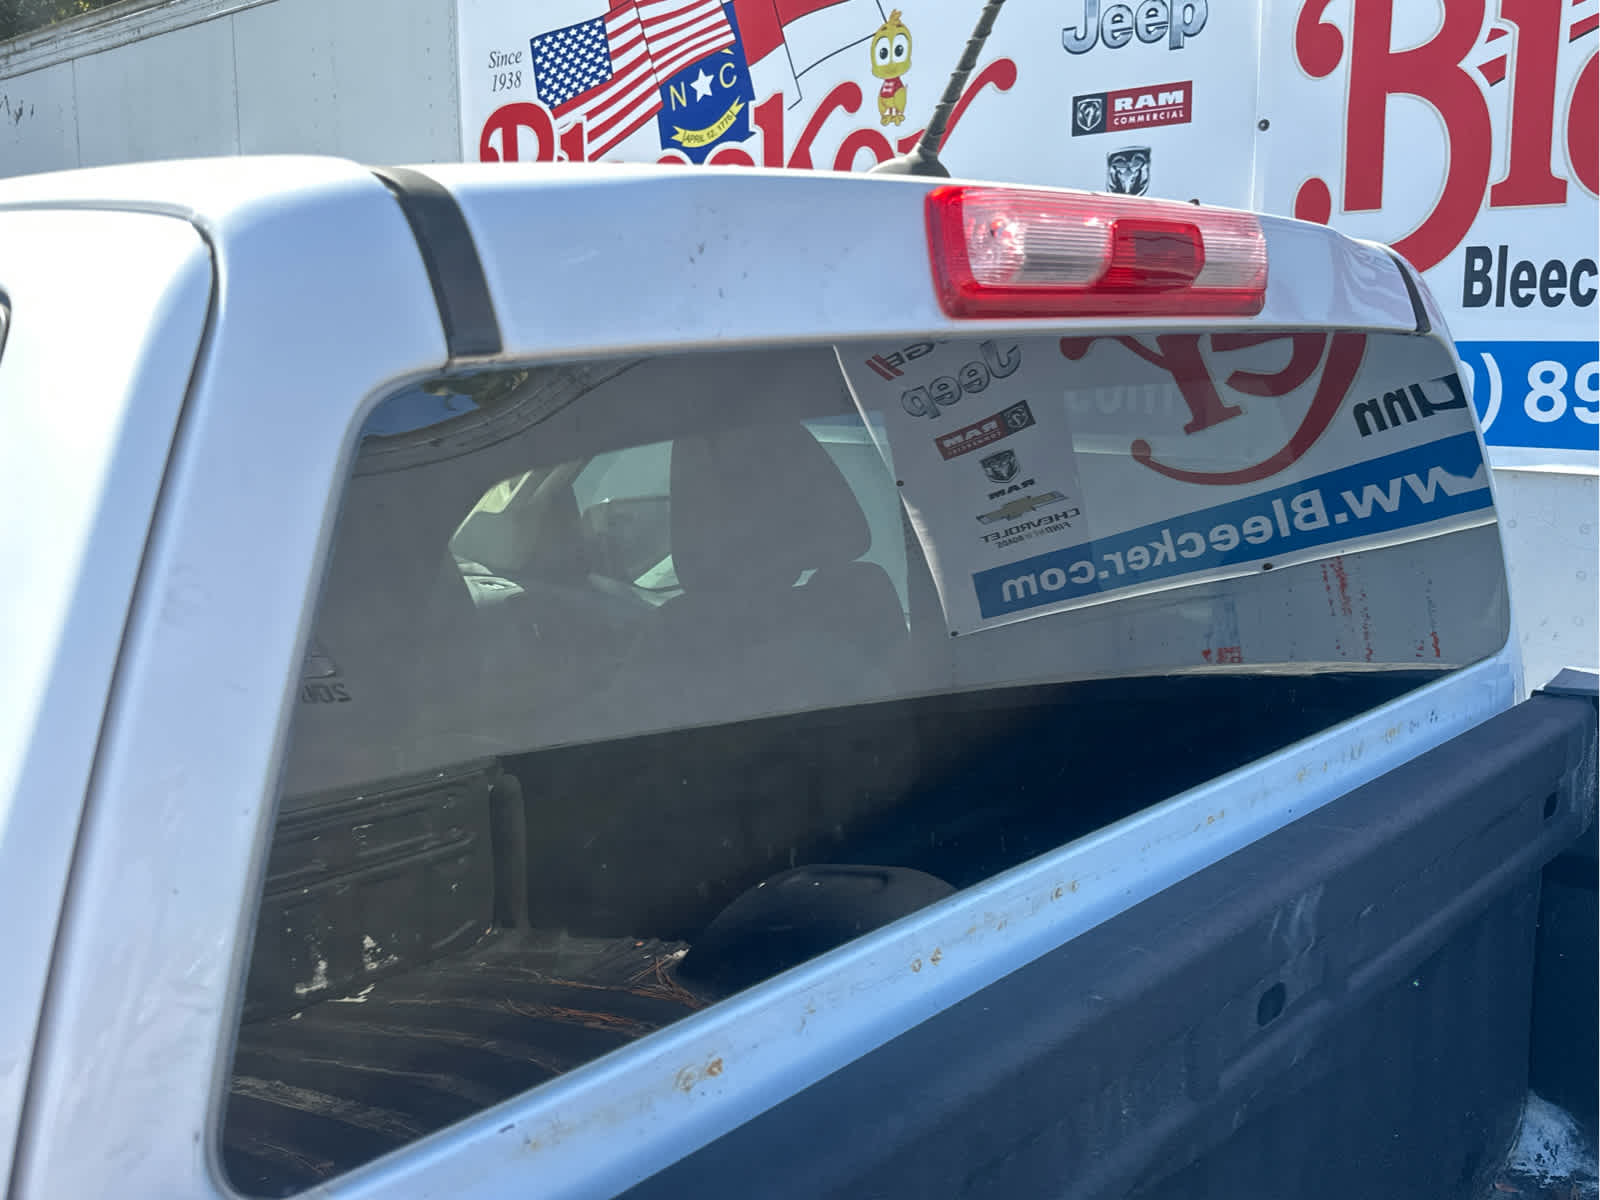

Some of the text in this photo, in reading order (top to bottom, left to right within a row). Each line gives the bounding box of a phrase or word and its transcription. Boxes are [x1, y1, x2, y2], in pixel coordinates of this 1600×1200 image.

[1062, 0, 1208, 54] Jeep
[488, 51, 522, 69] Since
[492, 70, 522, 92] 1938
[669, 62, 737, 112] N C
[1114, 90, 1184, 112] RAM
[1113, 110, 1184, 126] COMMERCIAL
[1462, 245, 1598, 308] Bleec
